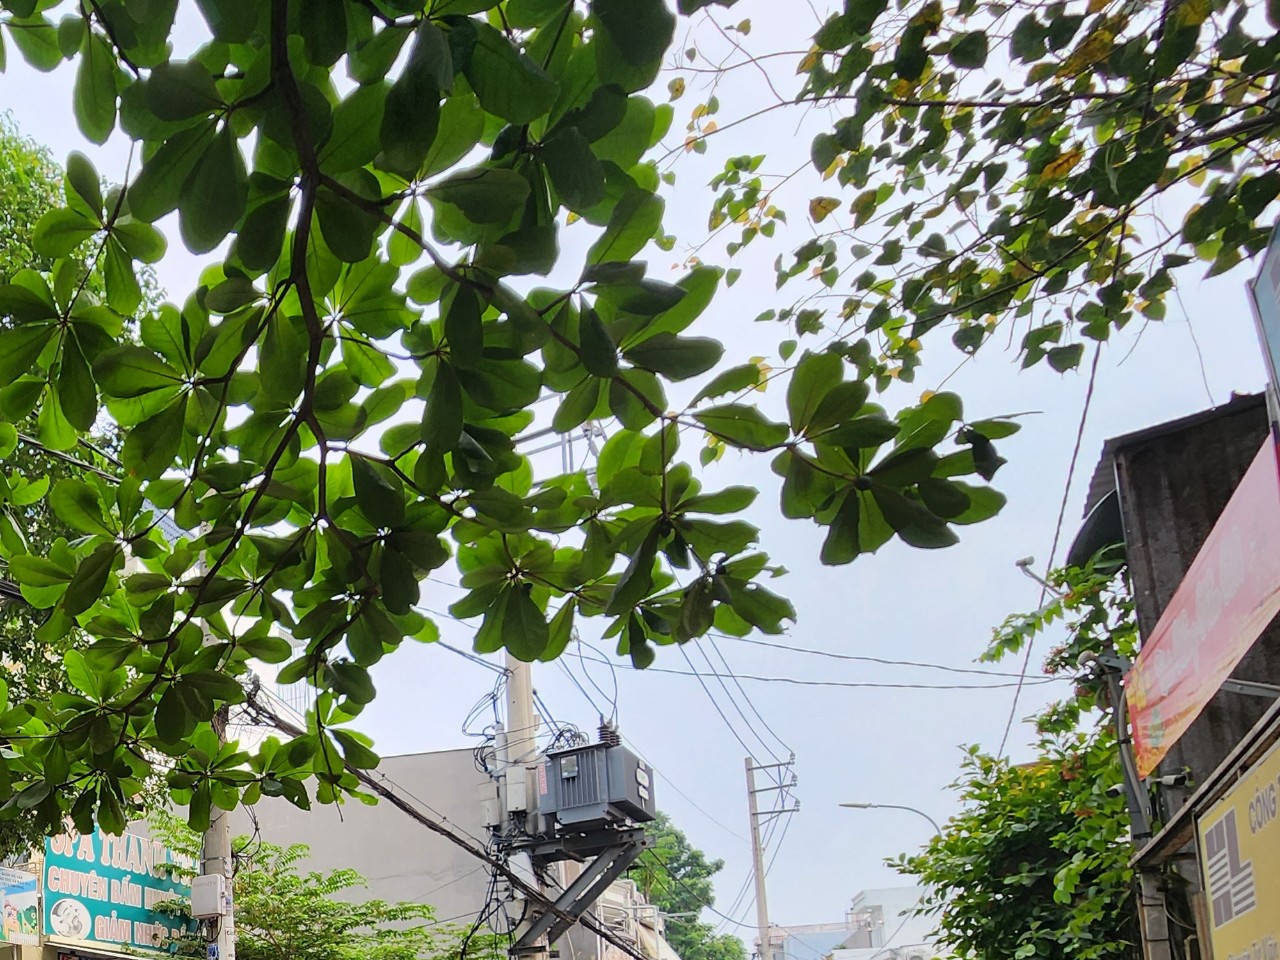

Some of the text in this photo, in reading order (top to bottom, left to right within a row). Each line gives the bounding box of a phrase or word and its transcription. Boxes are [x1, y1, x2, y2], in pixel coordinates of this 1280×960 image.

[48, 865, 109, 901] CHUYÊN
[111, 875, 142, 908] BẤM
[95, 910, 131, 943] GIẢM
